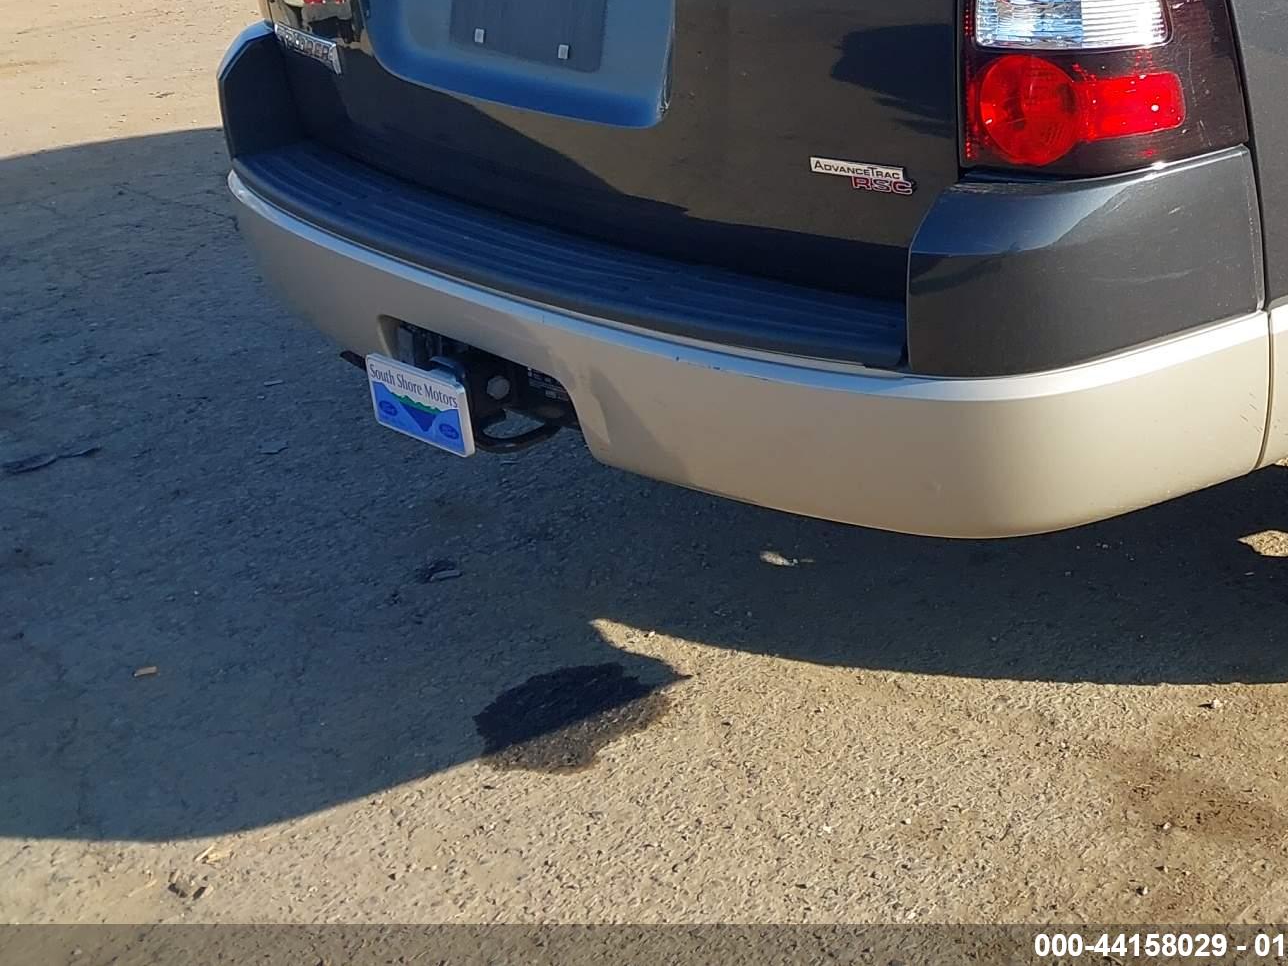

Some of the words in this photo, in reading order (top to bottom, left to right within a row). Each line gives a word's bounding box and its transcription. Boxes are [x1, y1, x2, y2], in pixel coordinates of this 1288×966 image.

[850, 175, 913, 195] RSC
[369, 364, 396, 386] South
[396, 373, 423, 396] Shore
[424, 384, 458, 408] Motors
